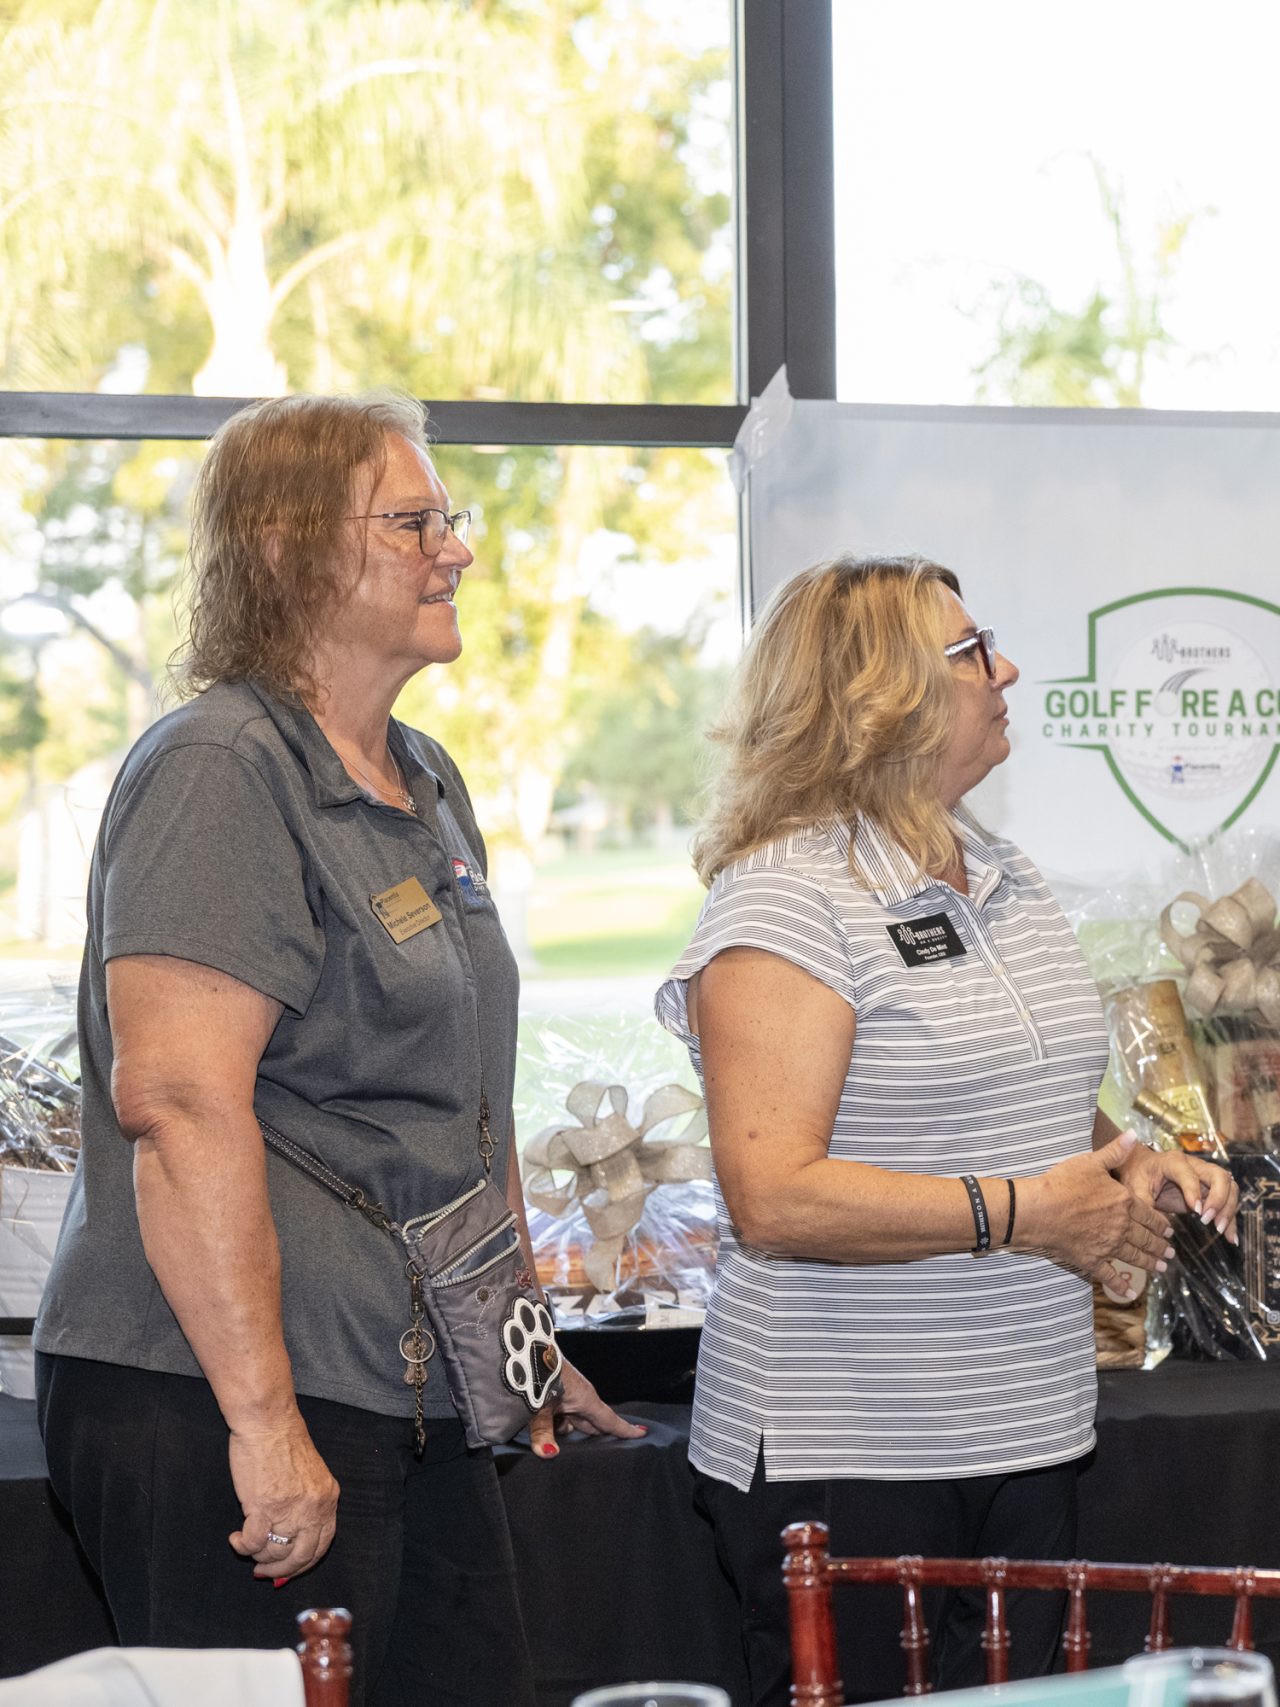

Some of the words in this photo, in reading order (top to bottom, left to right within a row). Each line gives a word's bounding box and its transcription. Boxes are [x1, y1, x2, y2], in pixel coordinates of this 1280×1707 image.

[1045, 689, 1126, 718] GOLF
[1227, 689, 1247, 717] A
[1043, 722, 1154, 738] CHARITY
[915, 926, 946, 940] BROTHERS
